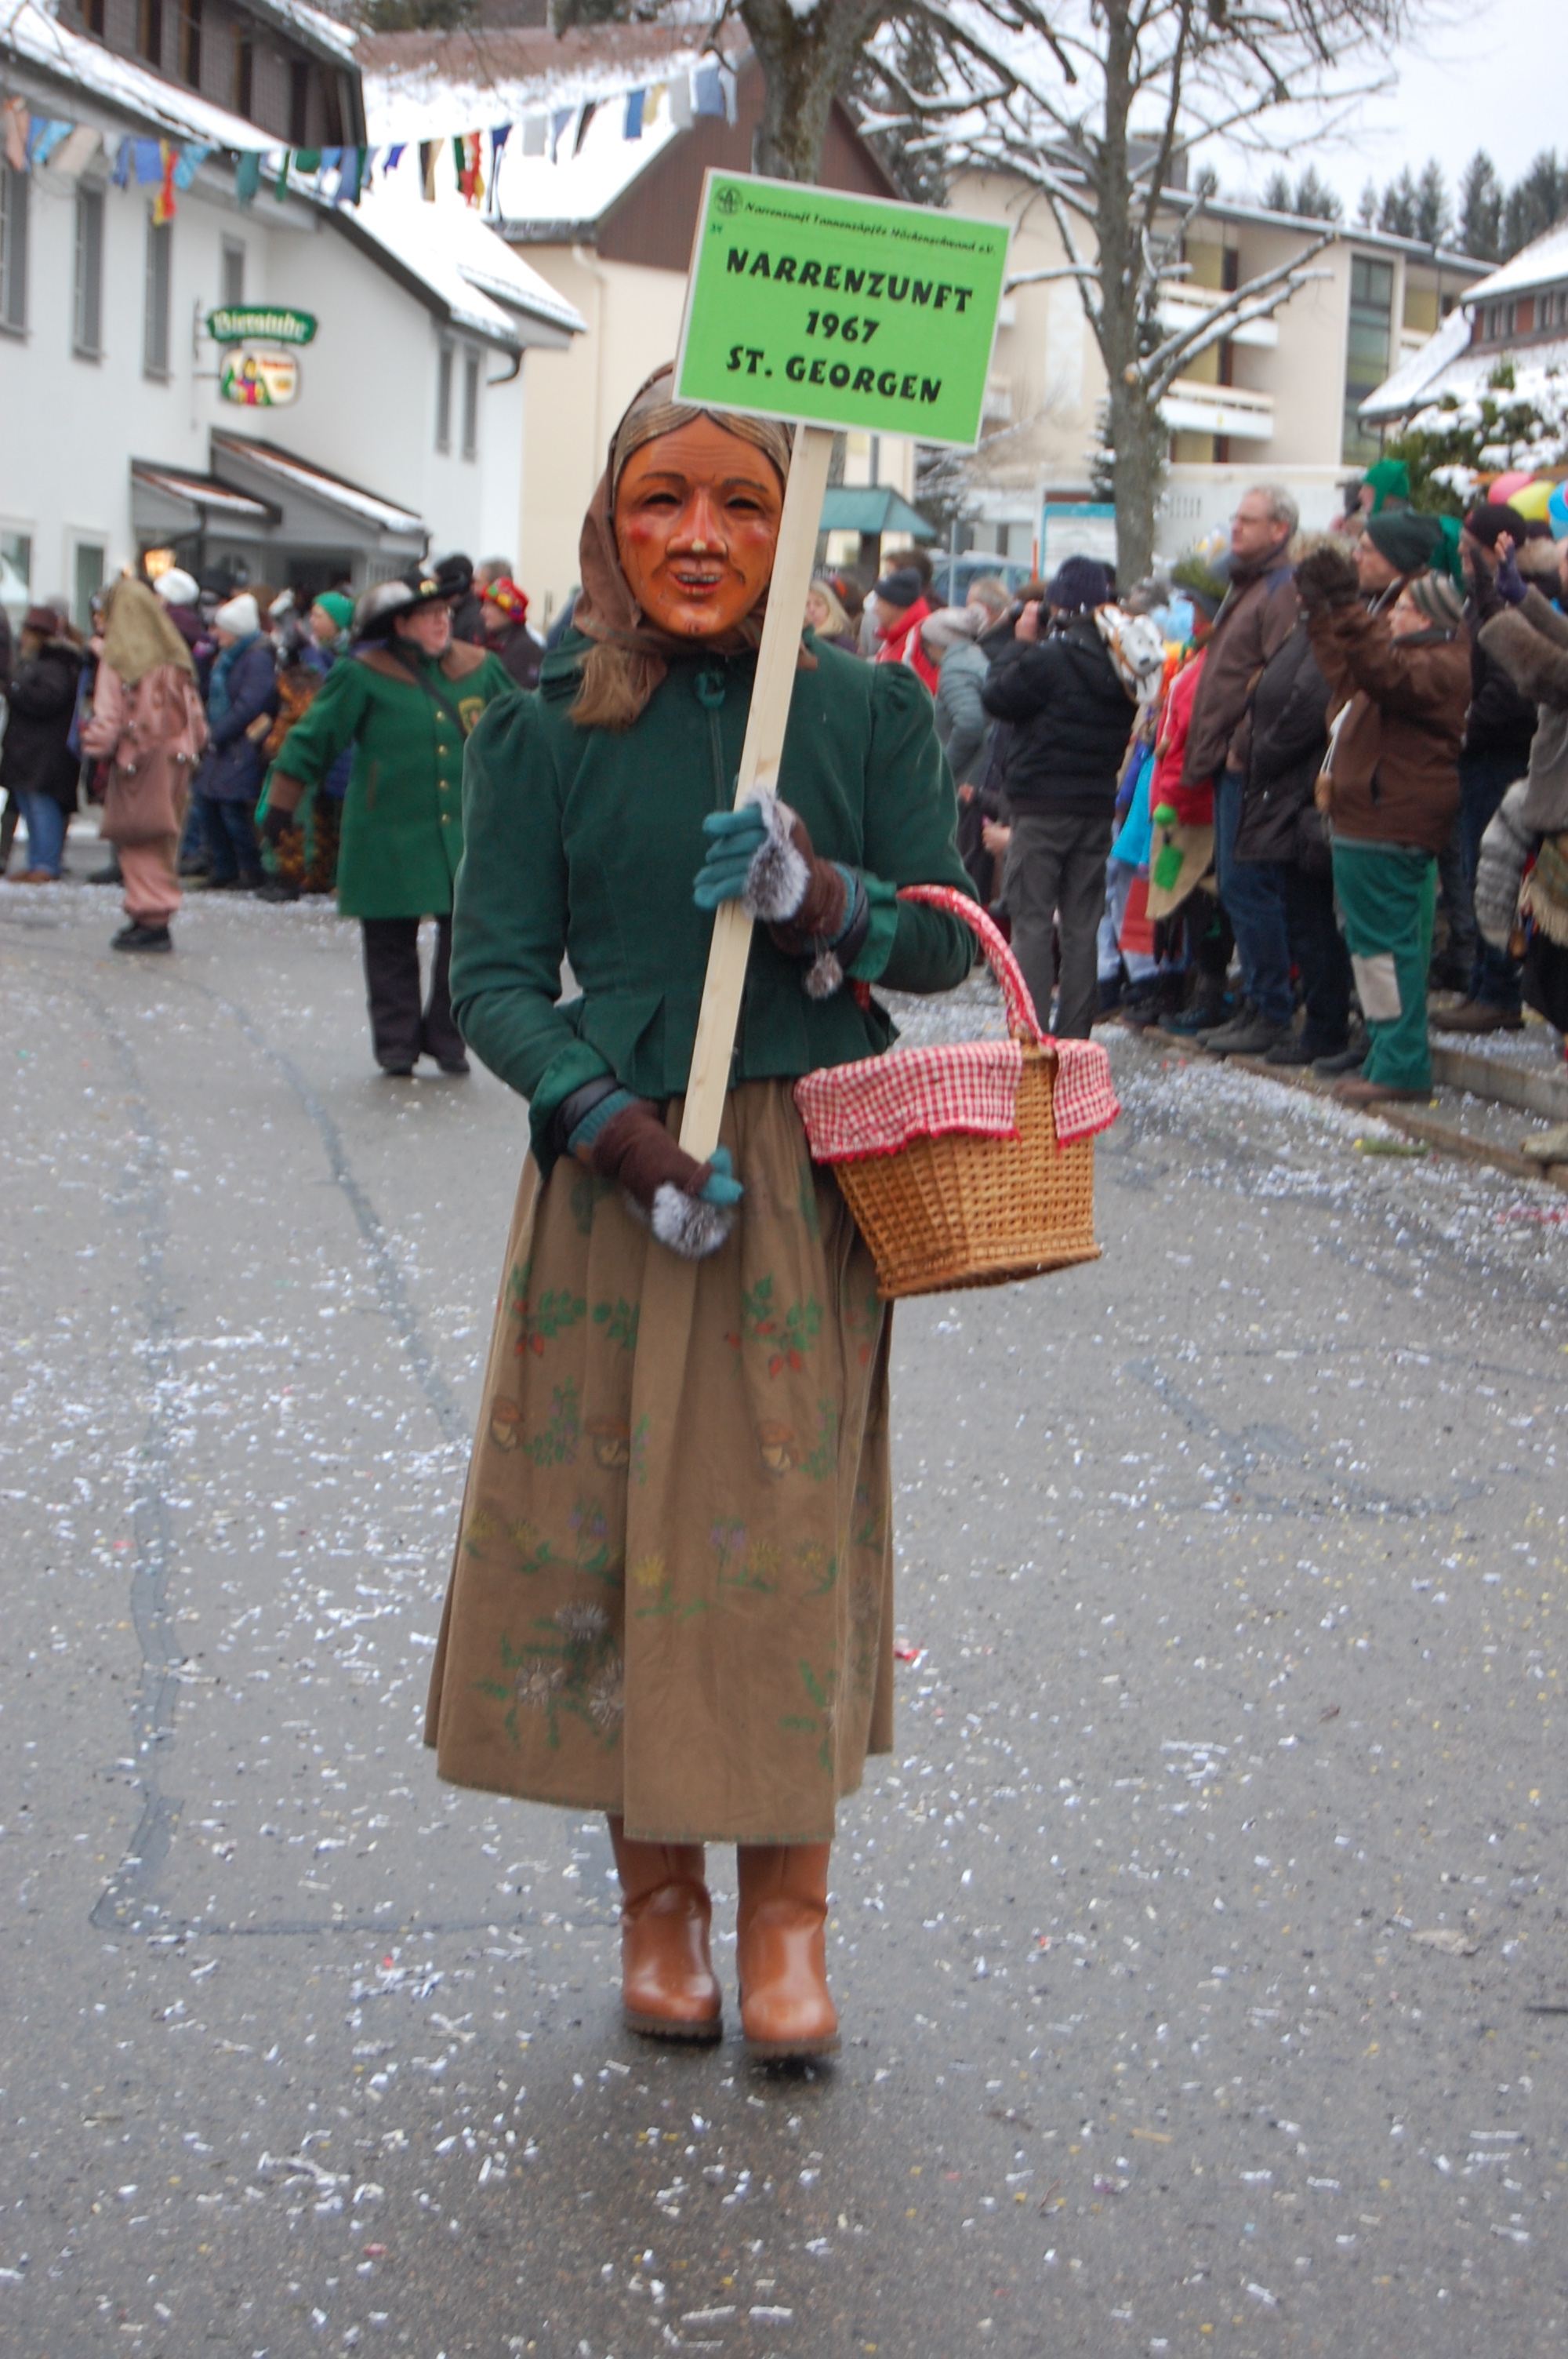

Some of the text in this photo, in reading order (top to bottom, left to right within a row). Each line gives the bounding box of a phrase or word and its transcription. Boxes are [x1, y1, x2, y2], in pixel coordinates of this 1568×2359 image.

[727, 247, 973, 313] NARRENZUNFT
[807, 311, 879, 343] 1967
[727, 346, 941, 403] ST. GEORGEN
